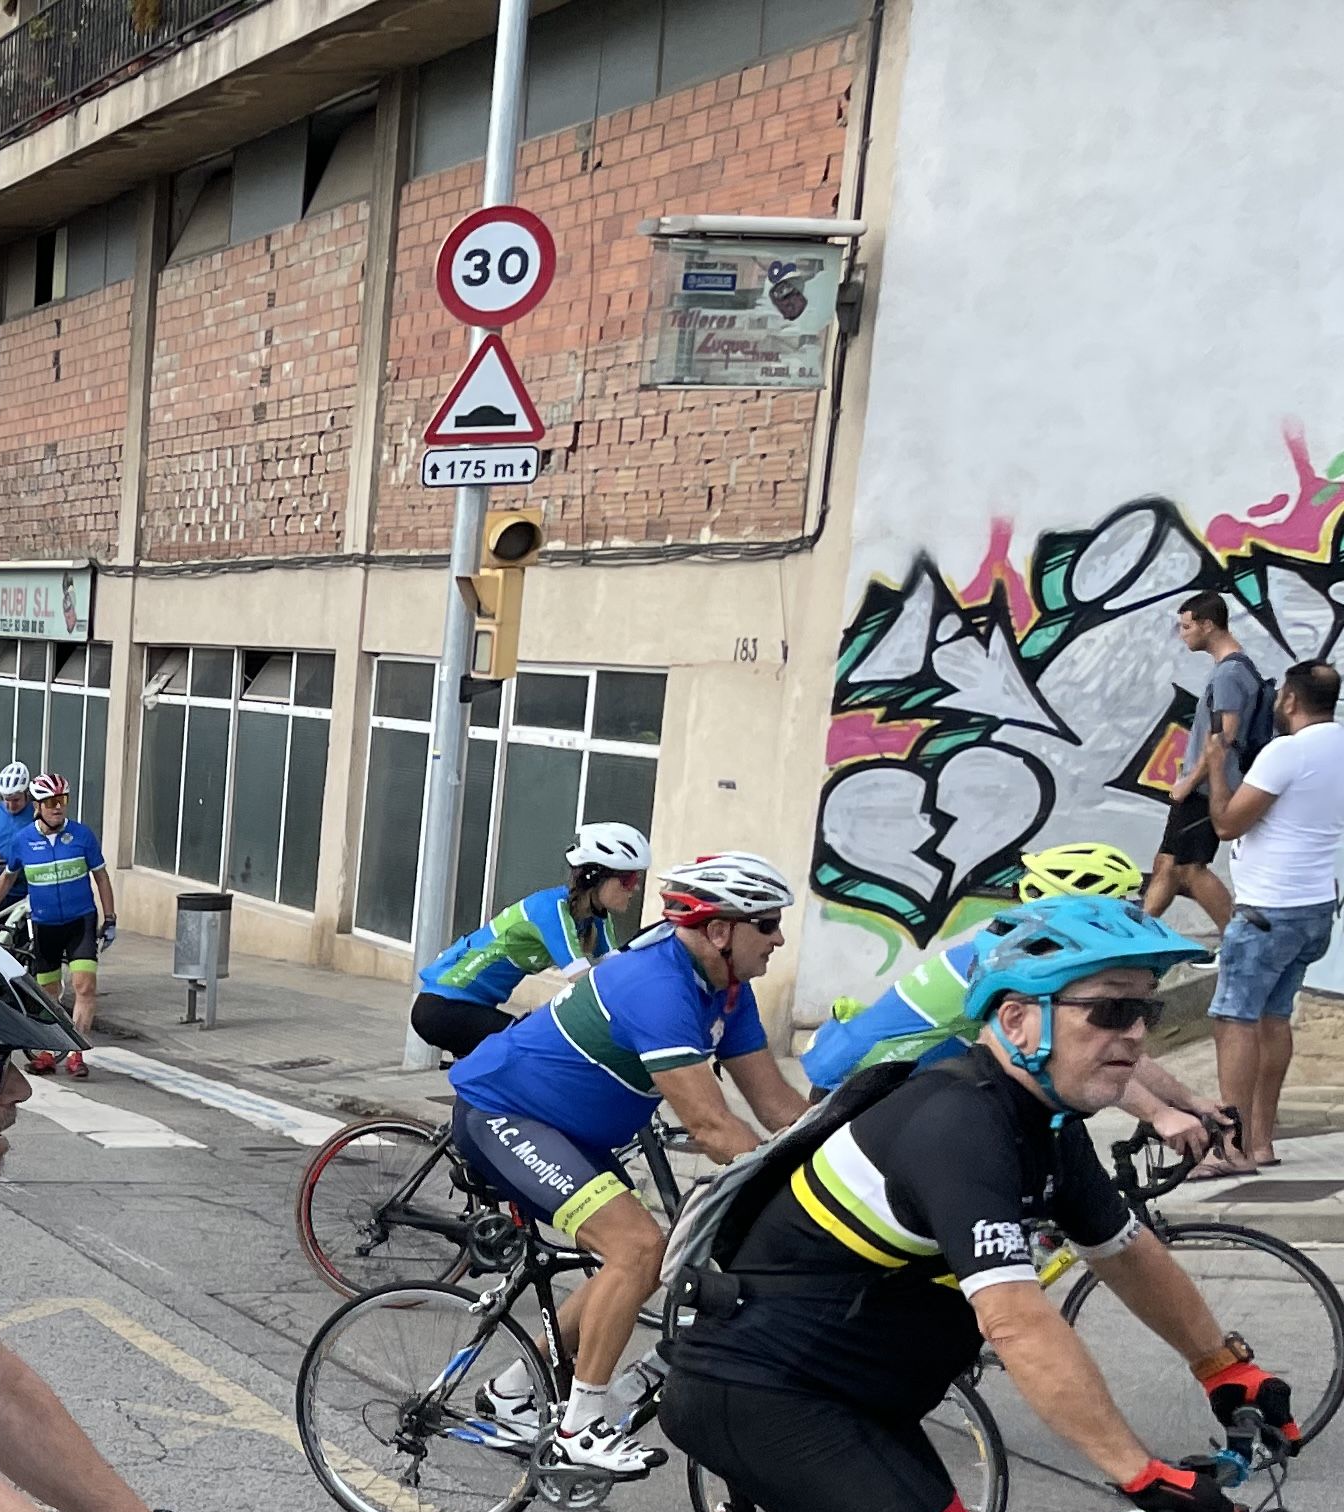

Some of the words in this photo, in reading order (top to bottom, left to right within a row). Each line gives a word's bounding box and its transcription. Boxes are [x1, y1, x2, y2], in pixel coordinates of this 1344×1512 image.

[461, 246, 529, 287] 30
[445, 460, 487, 481] 175
[493, 461, 515, 479] m
[733, 637, 759, 663] 183
[486, 1117, 520, 1147] A.C.
